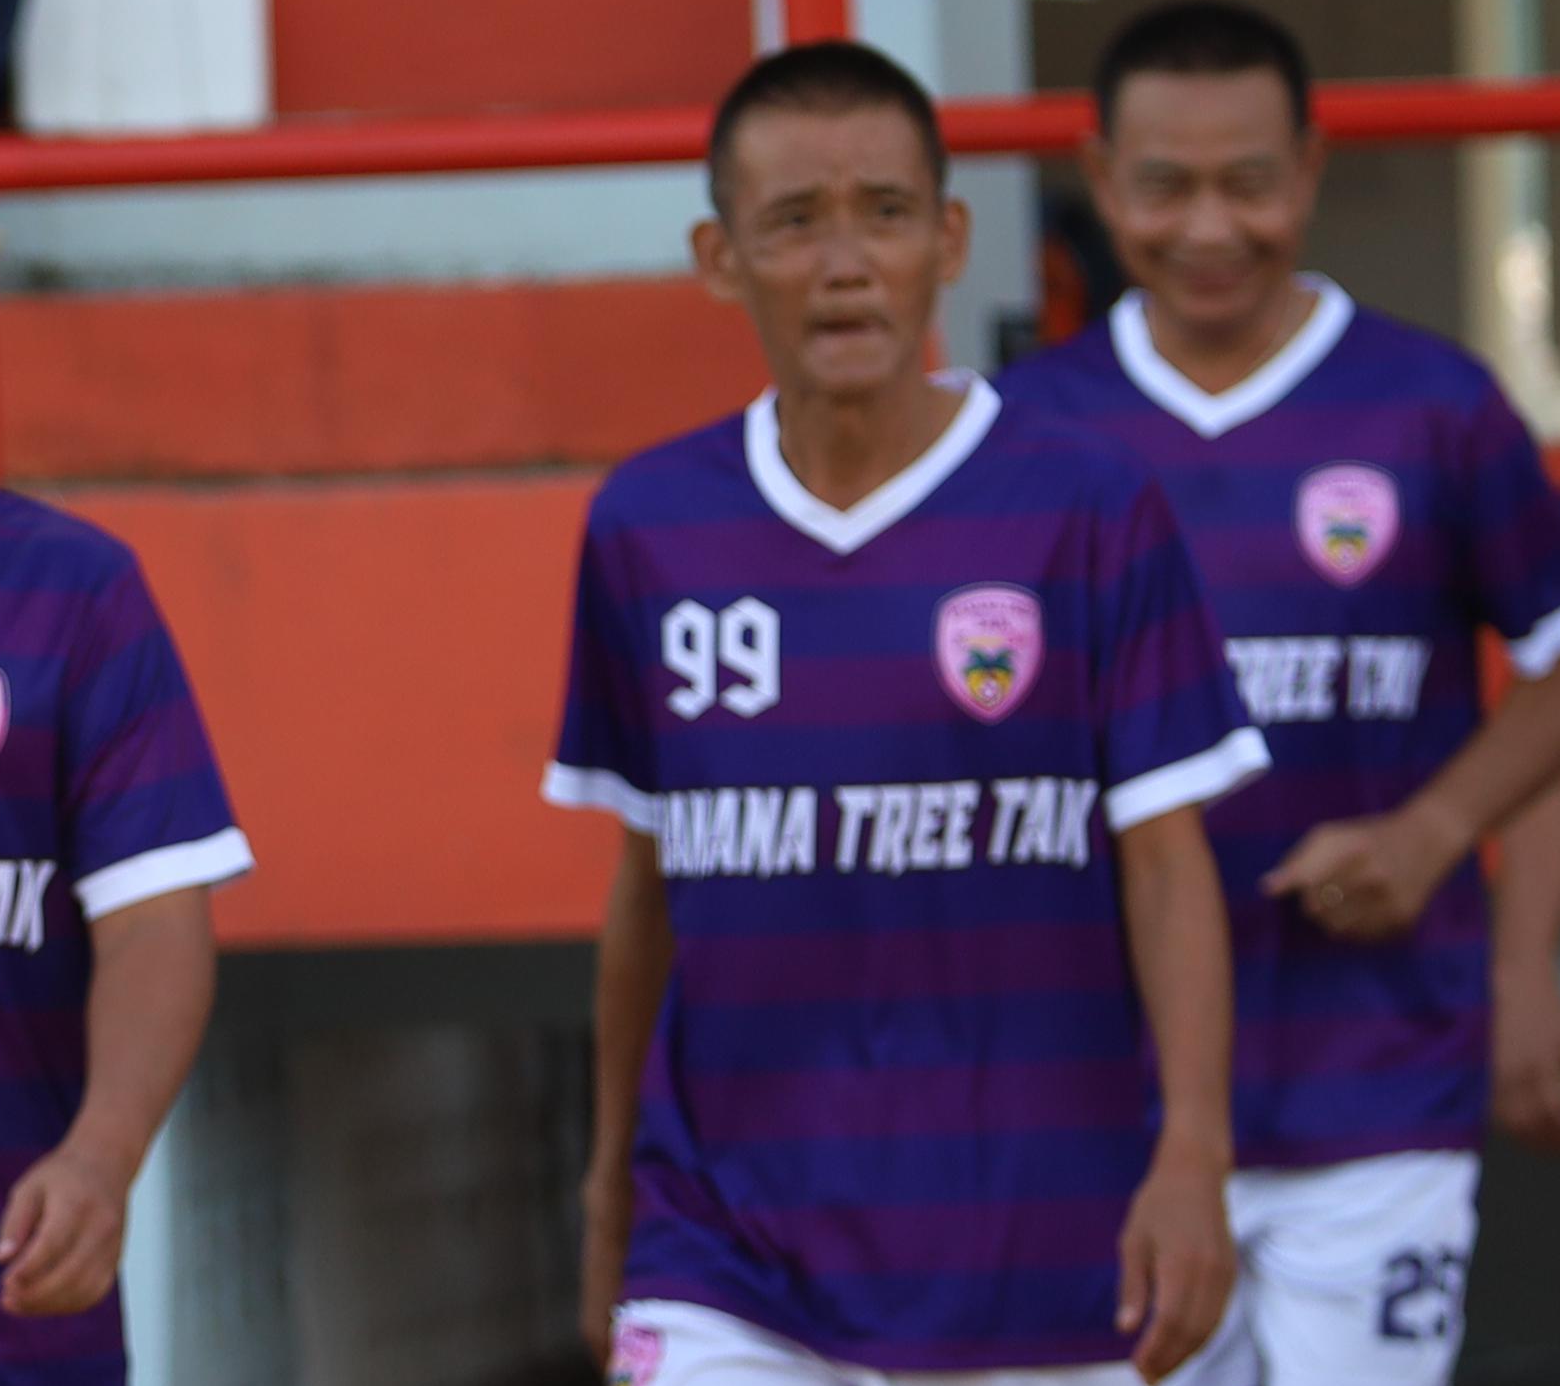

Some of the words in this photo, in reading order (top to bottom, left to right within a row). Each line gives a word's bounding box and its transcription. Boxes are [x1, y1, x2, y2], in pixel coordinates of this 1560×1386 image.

[661, 596, 782, 722] 99
[833, 779, 981, 878] TREE
[987, 776, 1099, 872] TAK
